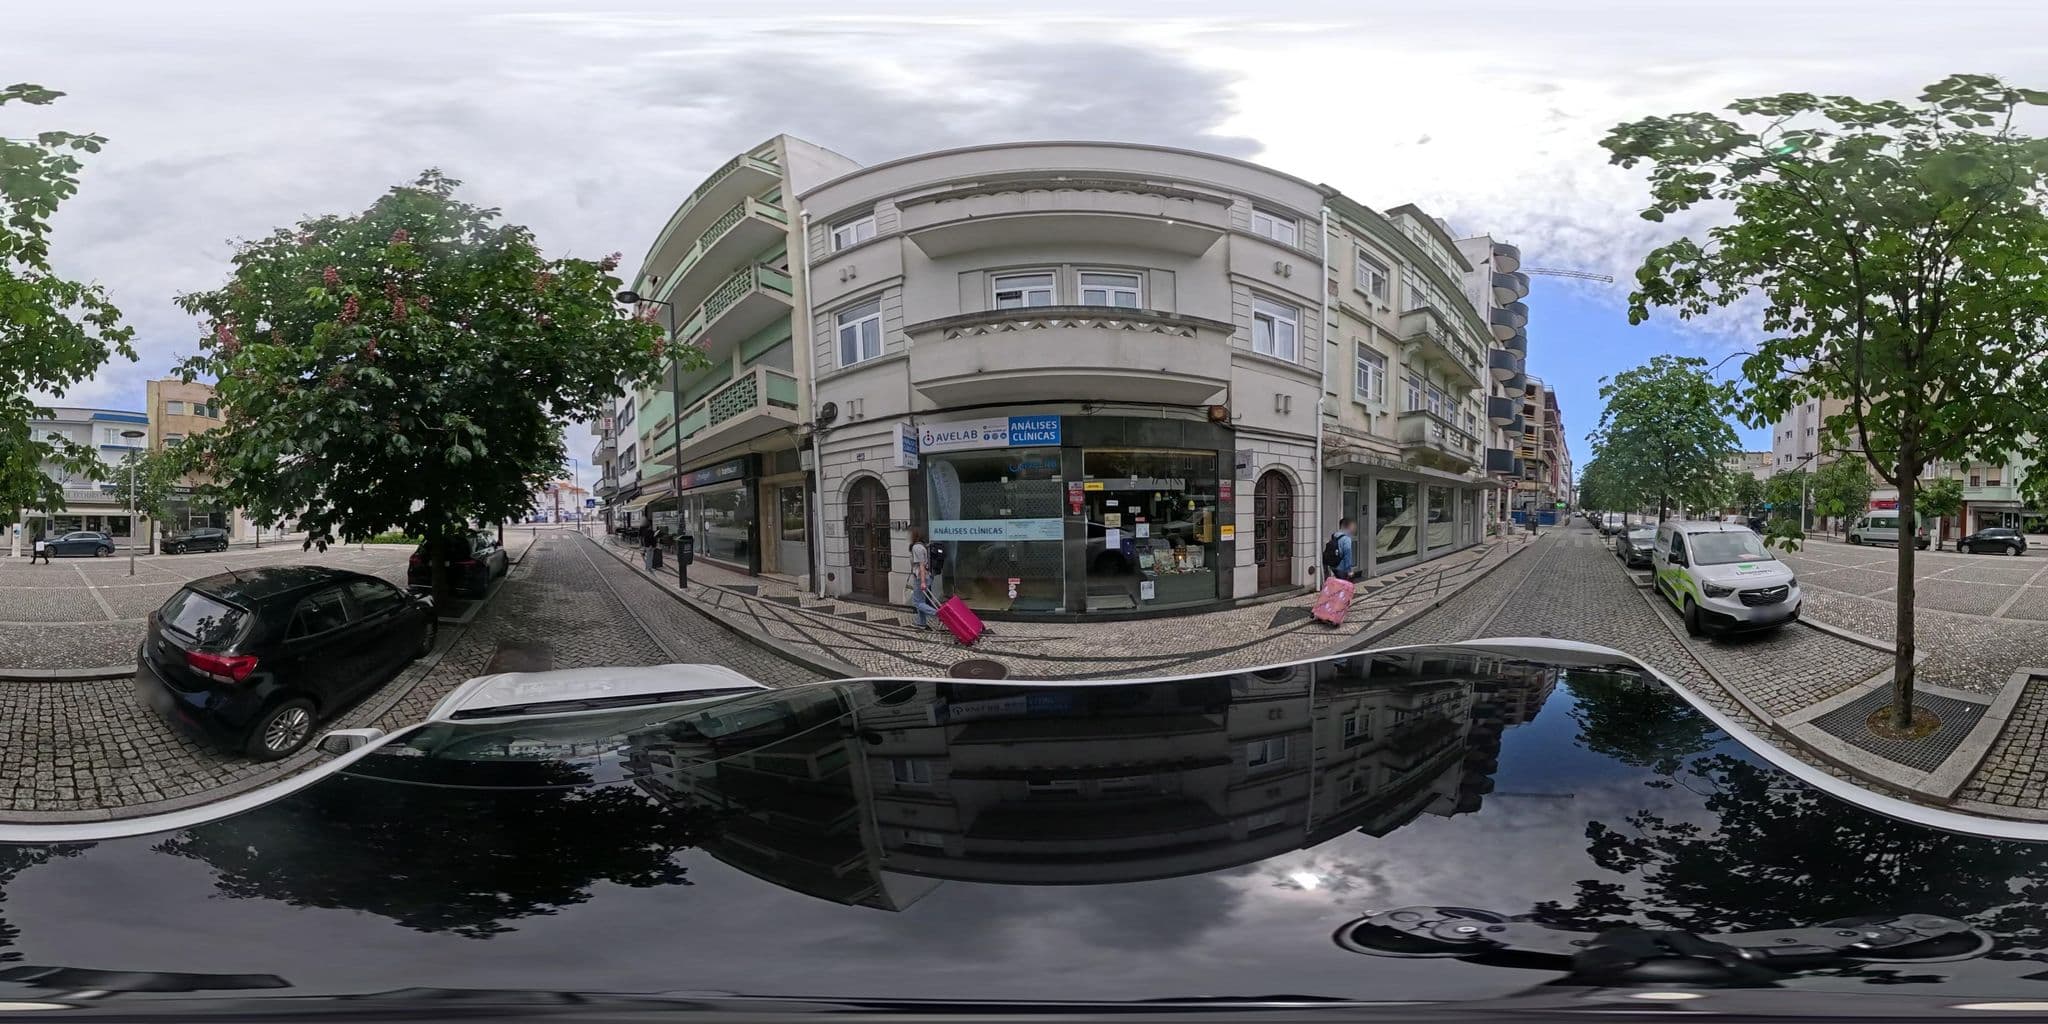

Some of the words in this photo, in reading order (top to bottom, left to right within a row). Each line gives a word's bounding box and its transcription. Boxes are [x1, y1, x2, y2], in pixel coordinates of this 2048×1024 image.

[1011, 420, 1057, 431] ANÁLISES
[936, 430, 978, 442] AVELAB
[1012, 431, 1056, 441] CLÍNICAS
[934, 526, 967, 535] ANÁLISES
[969, 526, 1003, 535] CLÍNICAS
